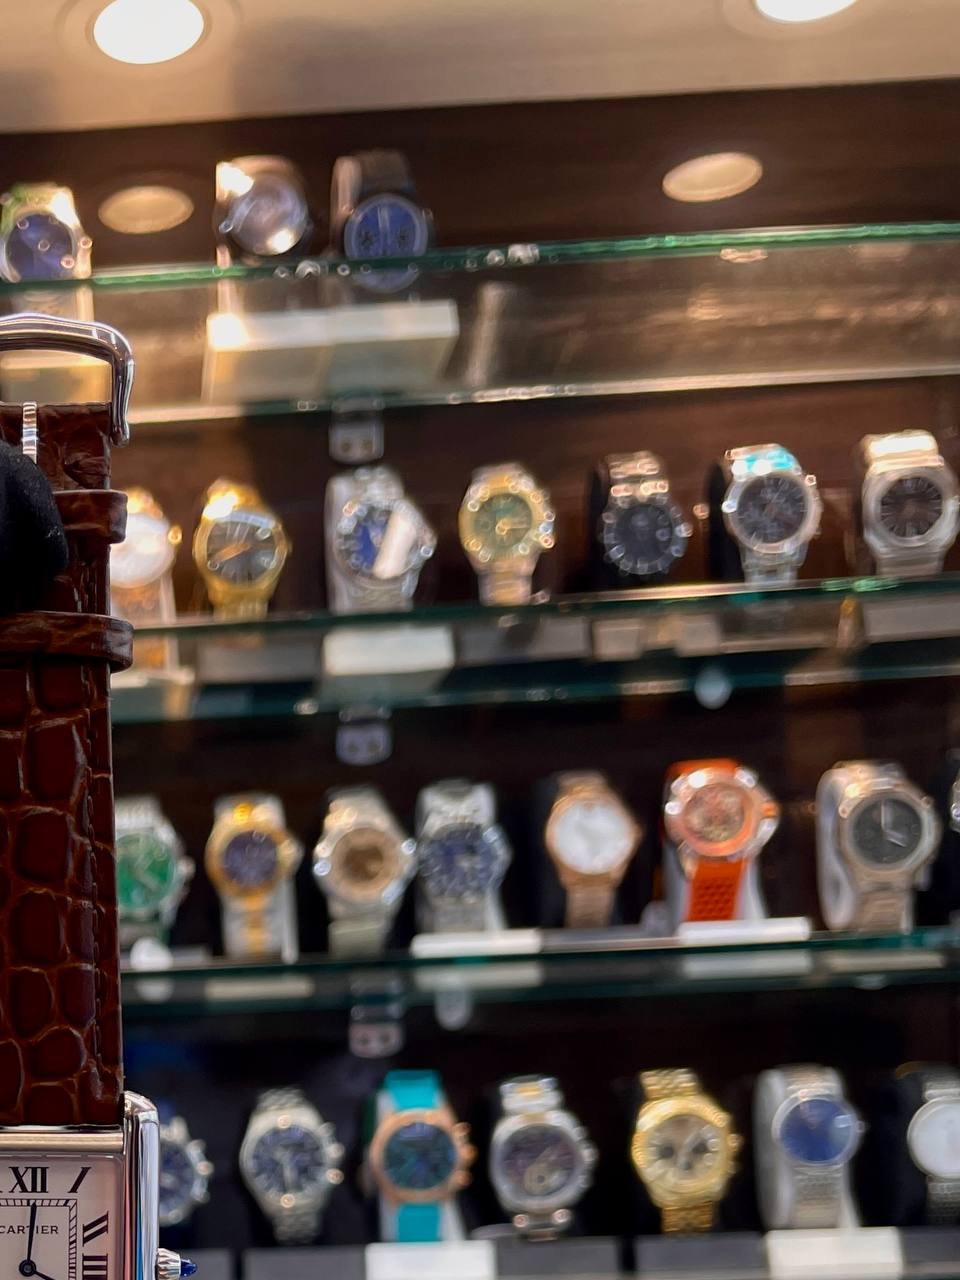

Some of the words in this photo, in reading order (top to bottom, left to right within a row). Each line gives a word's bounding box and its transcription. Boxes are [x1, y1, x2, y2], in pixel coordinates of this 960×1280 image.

[8, 1166, 50, 1194] XII
[68, 1166, 93, 1194] I
[82, 1210, 109, 1248] II
